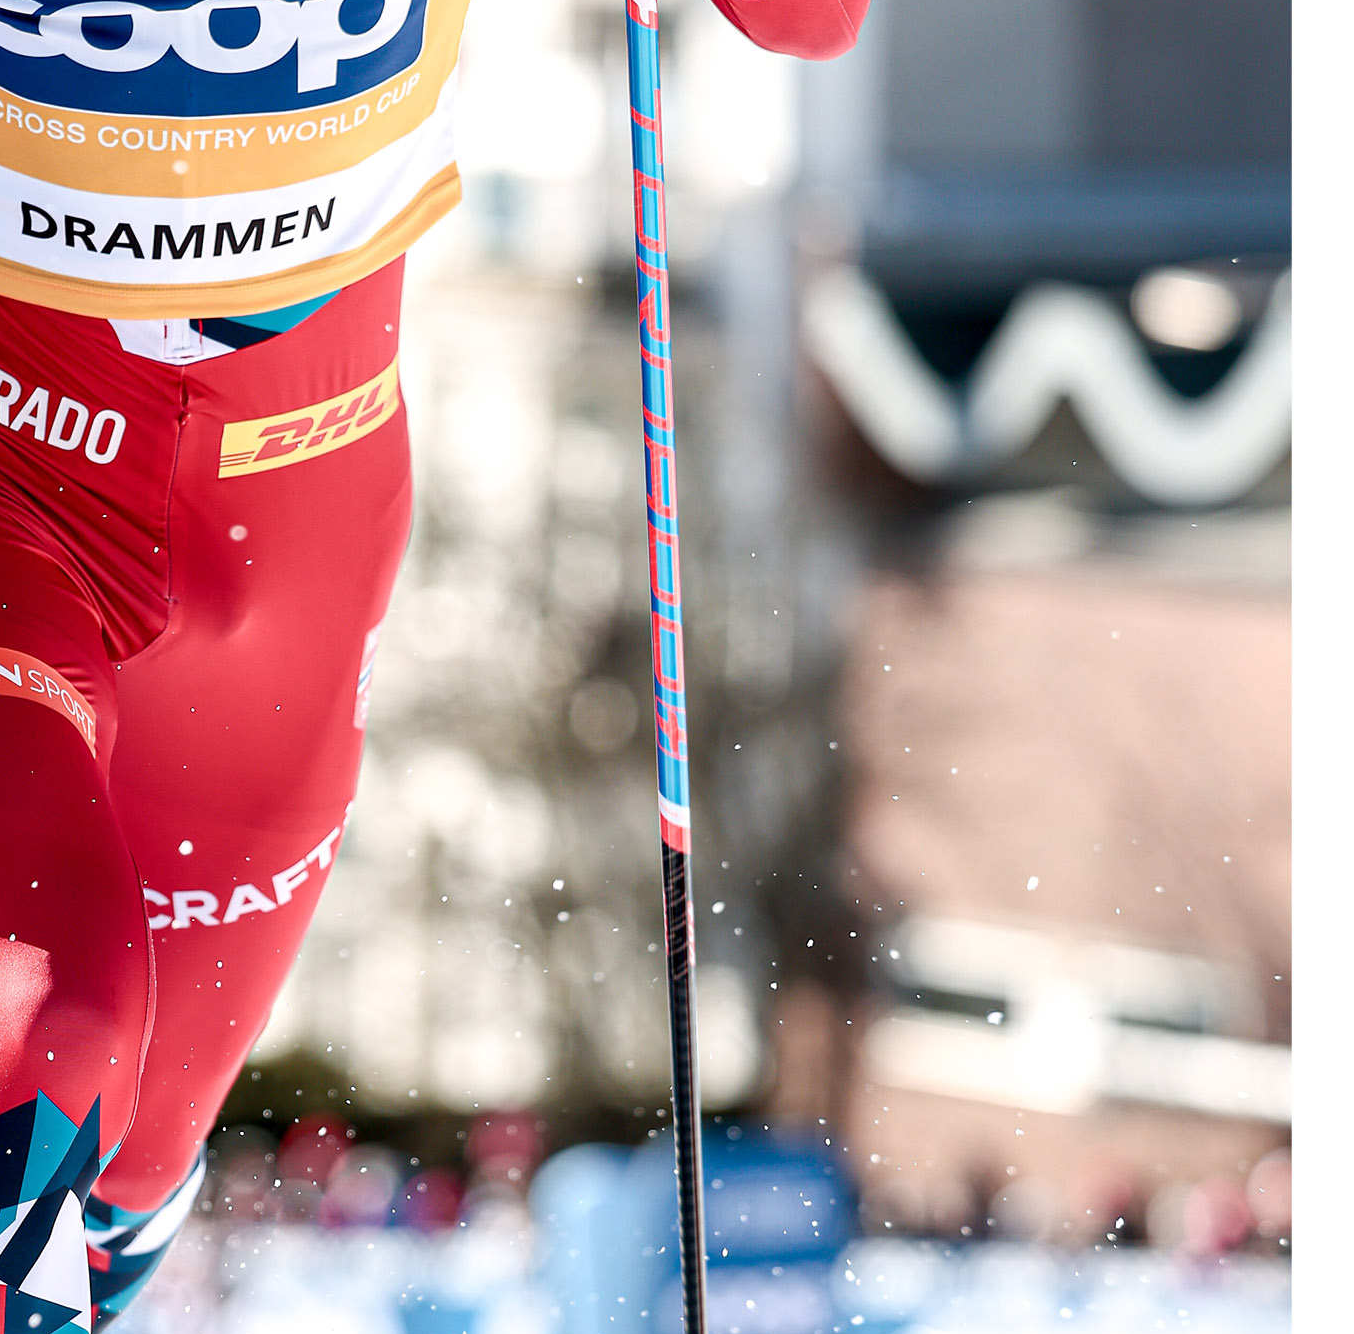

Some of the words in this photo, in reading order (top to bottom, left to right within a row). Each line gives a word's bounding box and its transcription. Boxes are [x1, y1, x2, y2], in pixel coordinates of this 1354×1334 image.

[97, 125, 256, 152] COUNTRY
[266, 107, 370, 146] WORLD
[376, 71, 421, 119] CUP
[20, 197, 337, 260] DRAMMEN
[251, 369, 398, 463] DHL
[27, 669, 94, 741] SPORT
[143, 825, 341, 930] CRAFT
